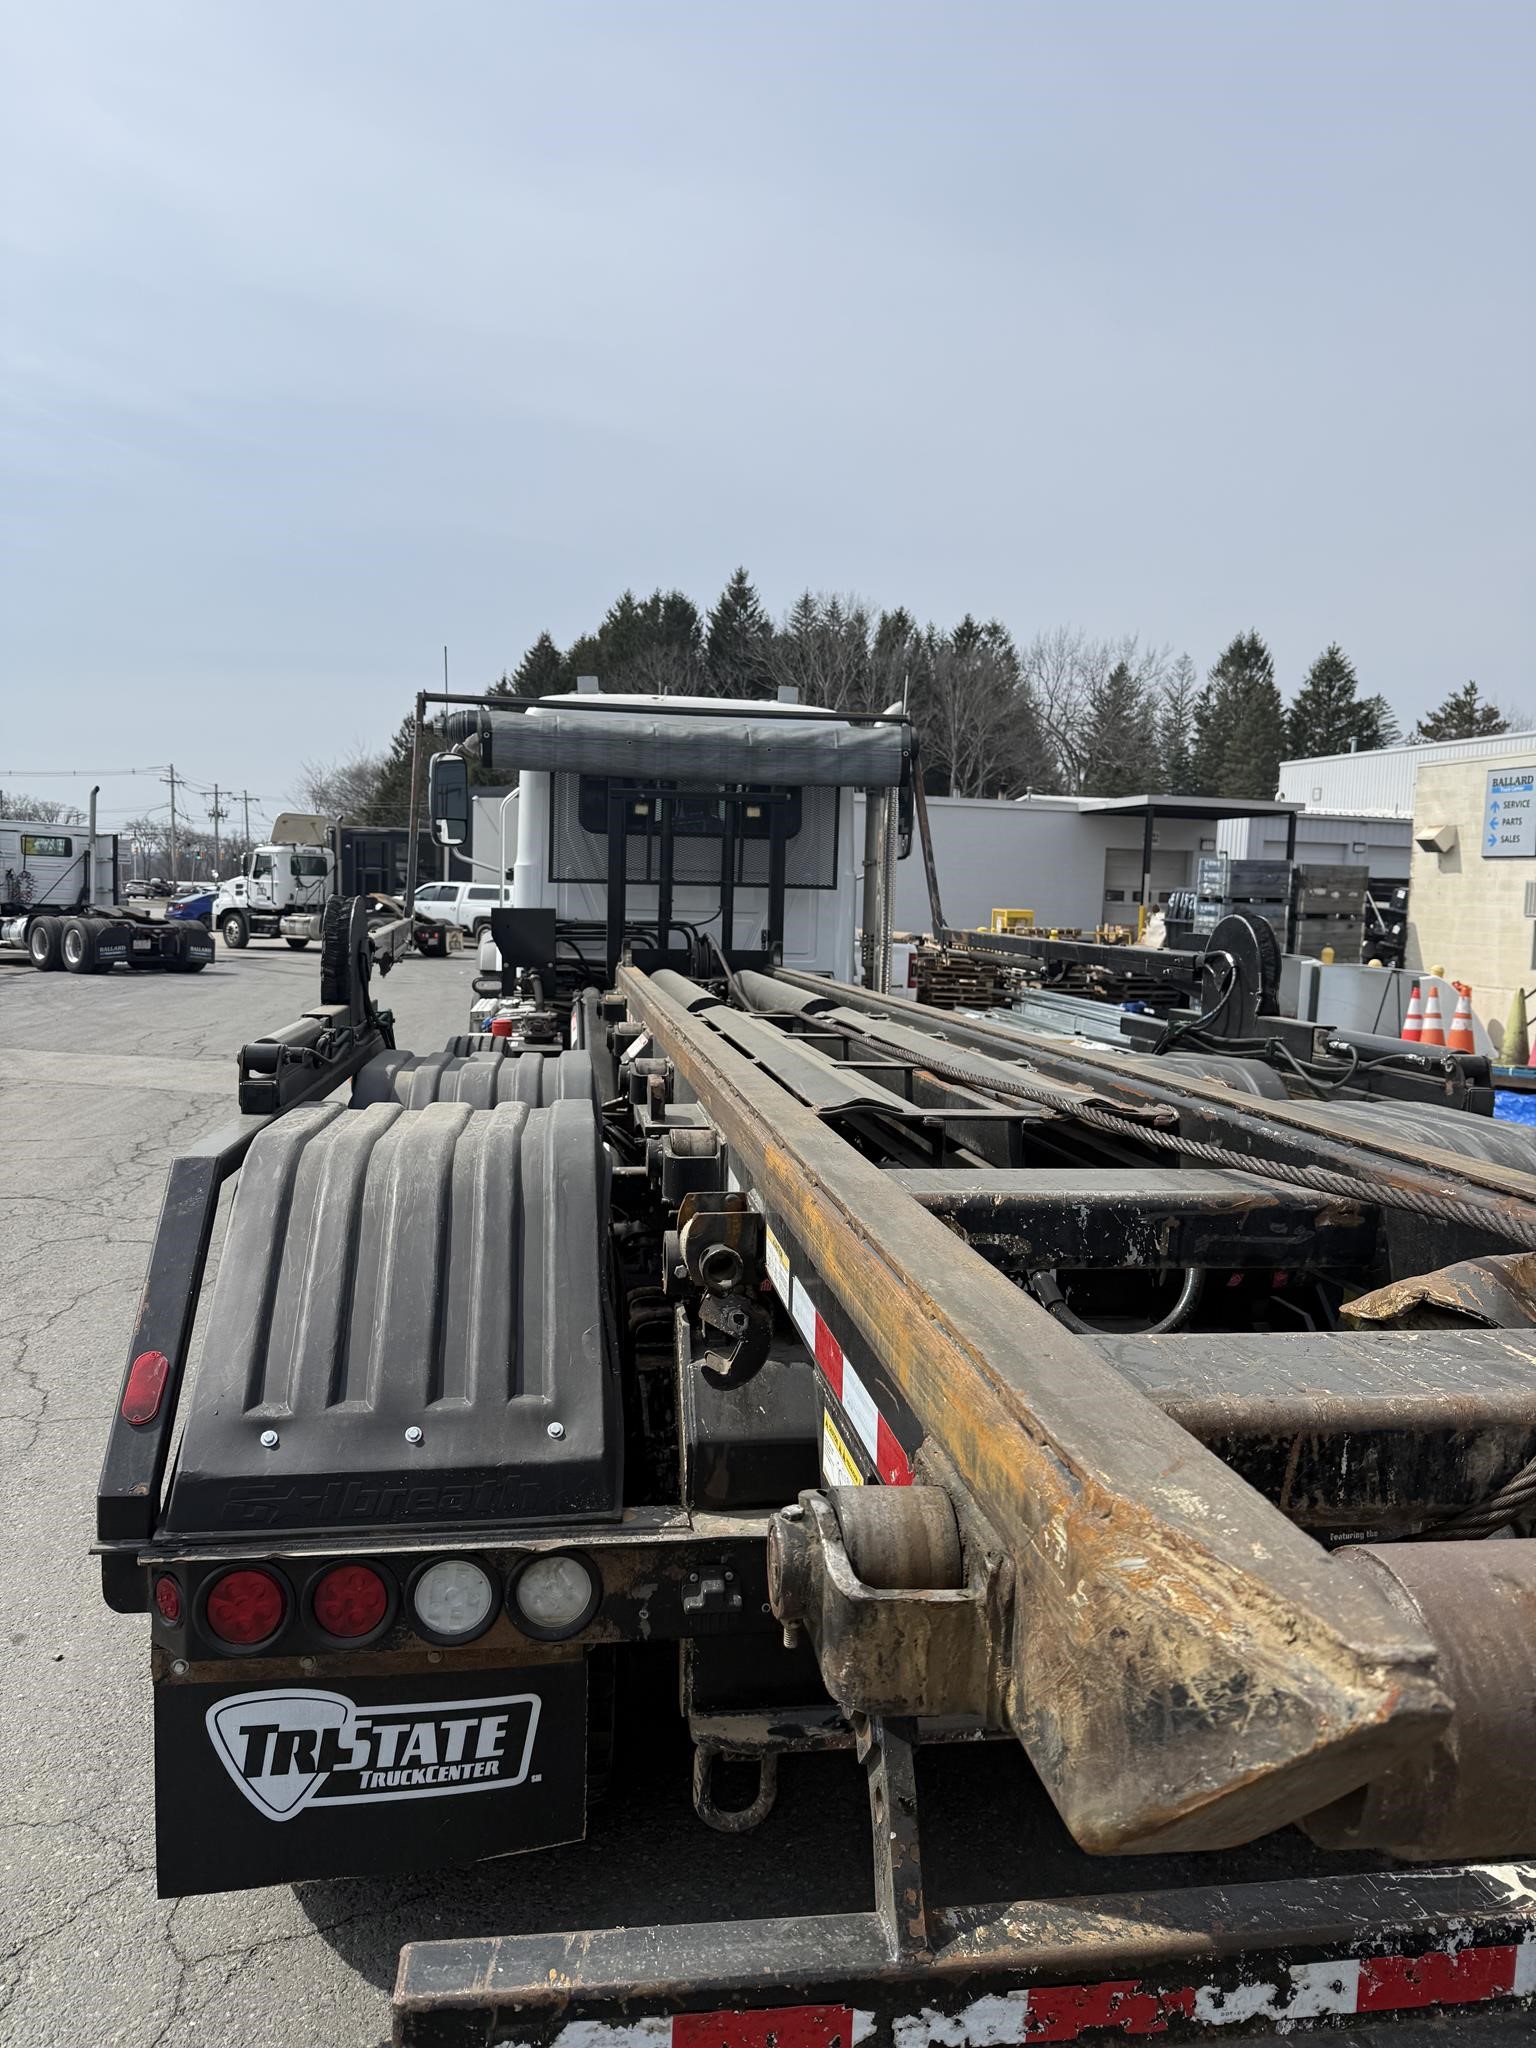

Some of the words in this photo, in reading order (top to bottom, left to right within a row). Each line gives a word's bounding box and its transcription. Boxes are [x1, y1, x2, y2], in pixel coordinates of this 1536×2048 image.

[1492, 775, 1534, 788] BALLARD
[1503, 799, 1530, 809] SERVICE
[1502, 817, 1522, 826] PARTS
[1500, 834, 1520, 843] SALES
[99, 945, 127, 953] BALLARD
[190, 945, 212, 953] BALLARD
[1330, 1530, 1364, 1541] Featuring
[1366, 1529, 1378, 1538] the
